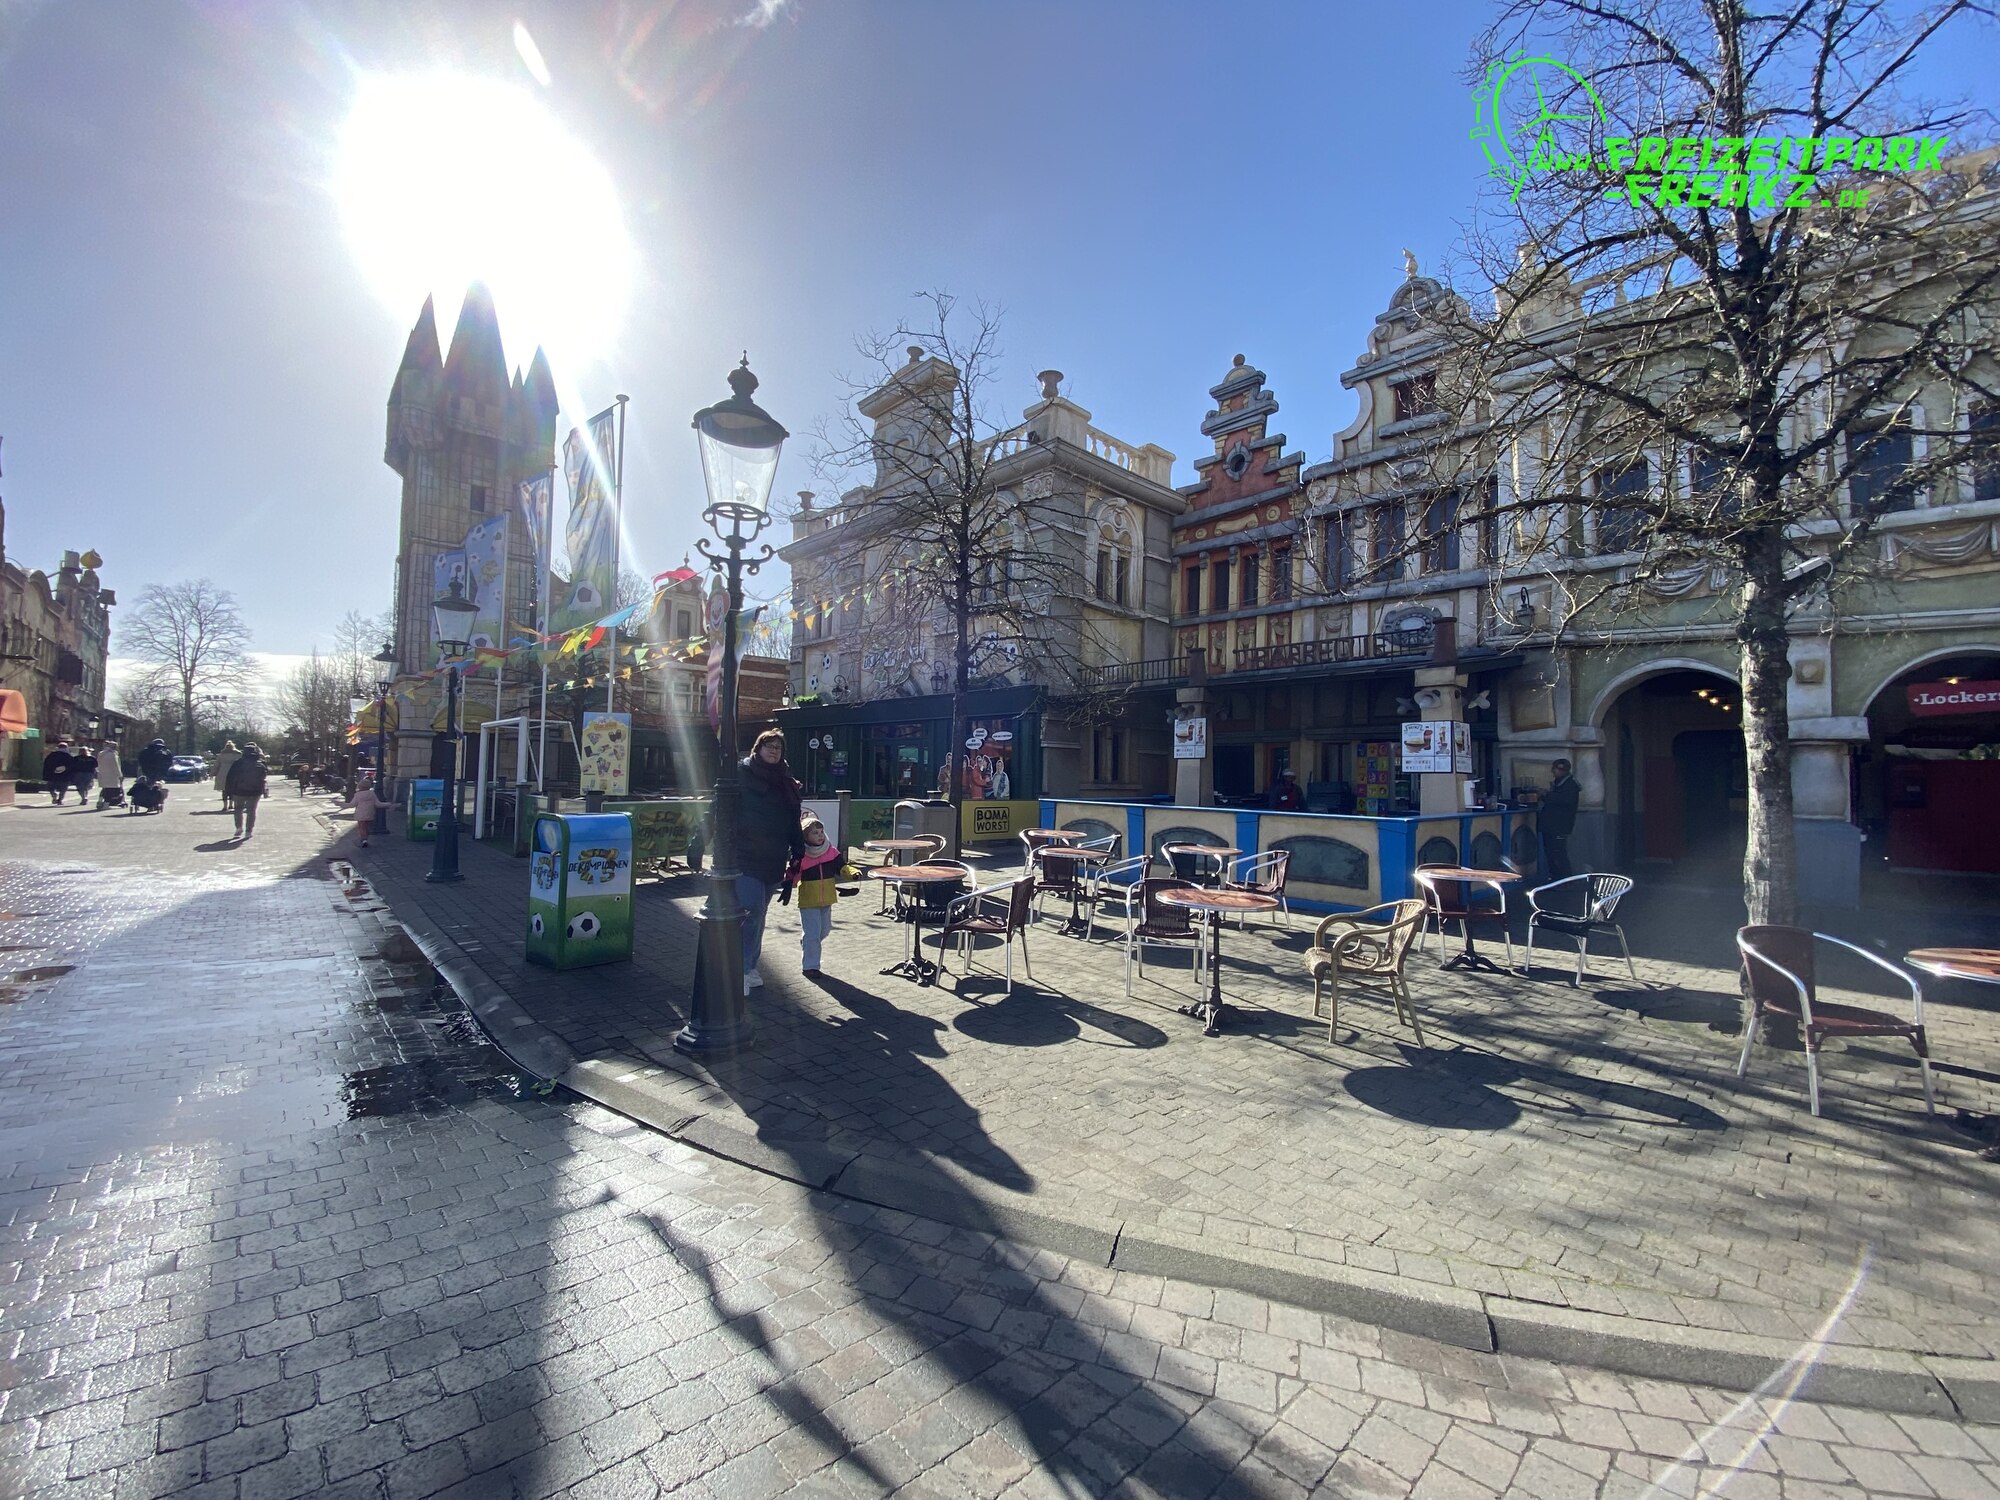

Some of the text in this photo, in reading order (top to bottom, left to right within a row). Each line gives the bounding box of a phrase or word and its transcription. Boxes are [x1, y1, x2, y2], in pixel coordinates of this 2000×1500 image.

[1919, 691, 2000, 705] Locker
[976, 809, 1008, 821] BOMA
[976, 820, 1008, 832] WORST
